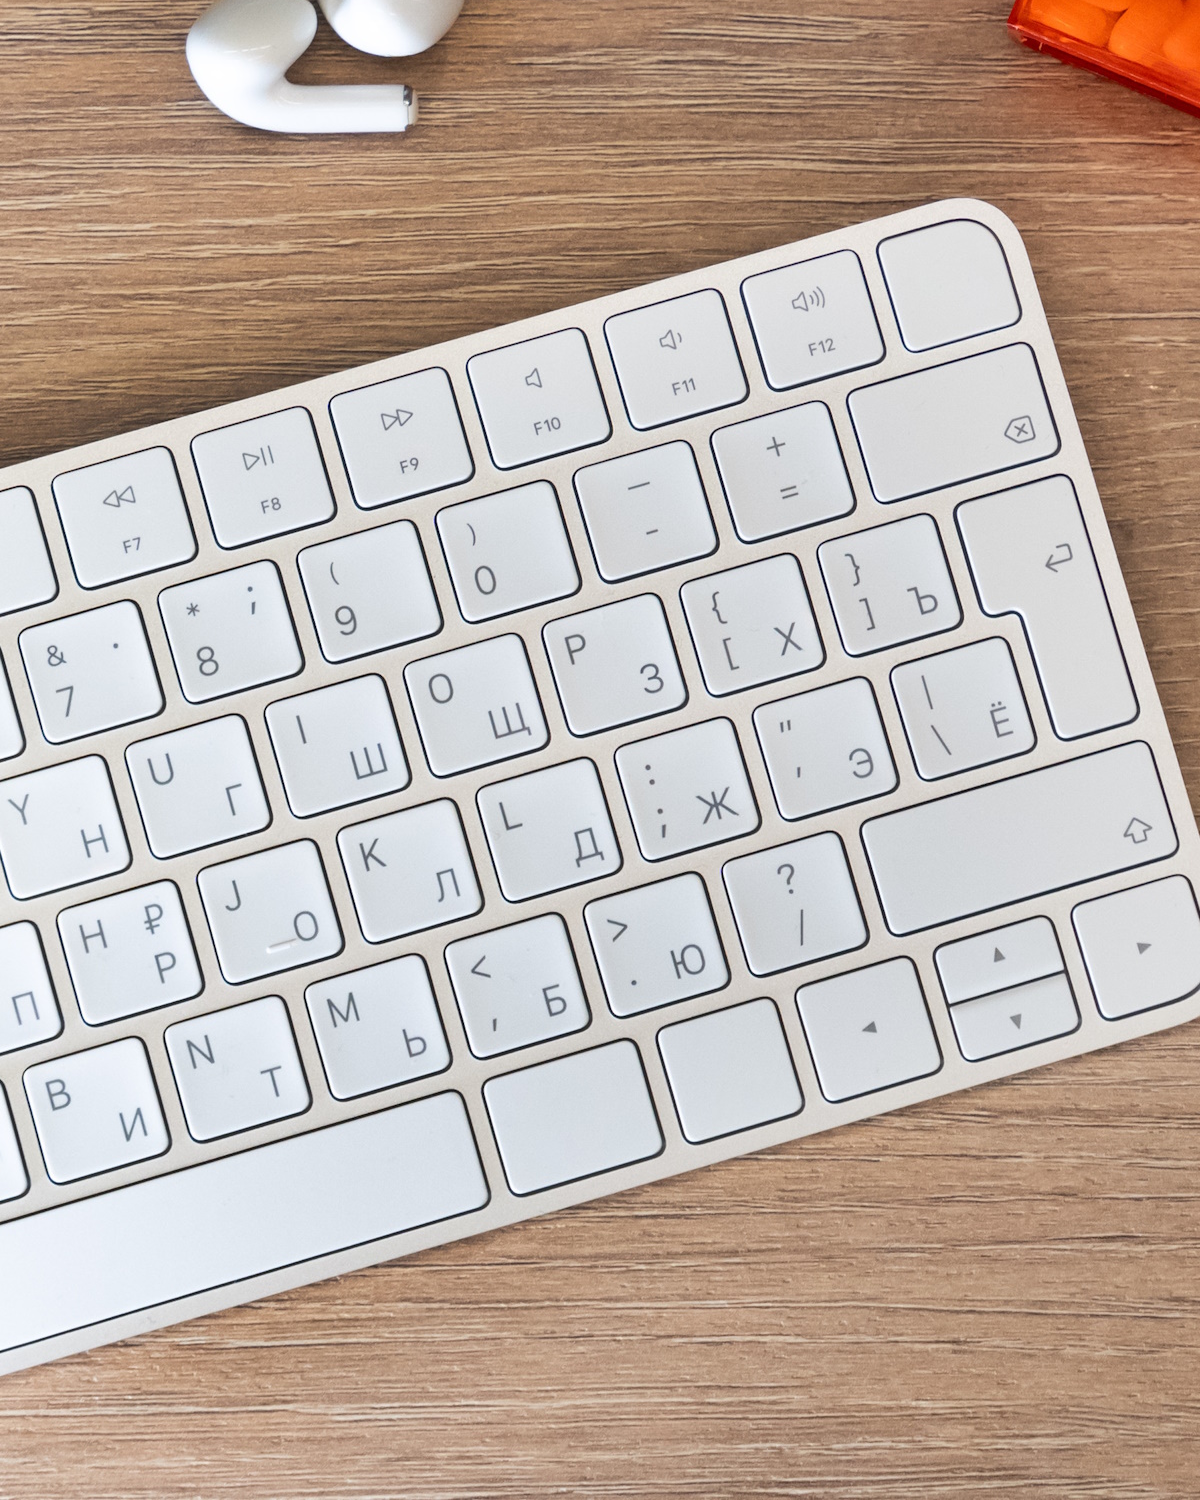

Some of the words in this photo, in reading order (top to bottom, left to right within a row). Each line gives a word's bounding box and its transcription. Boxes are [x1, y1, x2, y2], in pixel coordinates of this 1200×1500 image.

[808, 338, 836, 356] F12
[672, 378, 696, 396] F11
[533, 417, 561, 436] F10
[399, 457, 419, 474] F9
[260, 497, 281, 514] F8
[122, 537, 141, 554] F7
[907, 586, 939, 615] Ъ
[334, 605, 358, 636] 9
[47, 645, 68, 668] &
[196, 646, 219, 678] 8
[564, 634, 587, 665] P
[55, 685, 75, 718] 7
[488, 702, 532, 739] Щ
[989, 701, 1014, 738] Ё
[147, 753, 174, 786] U
[349, 743, 388, 780] Ш
[849, 748, 875, 779] Э
[8, 794, 30, 826] Y
[225, 783, 242, 816] Г
[696, 786, 739, 826] Ж
[498, 802, 523, 831] L
[80, 824, 110, 858] Н
[359, 838, 388, 872] K
[574, 827, 605, 868] Д
[436, 868, 461, 903] Л
[777, 863, 796, 895] ?
[225, 880, 242, 912] J
[79, 919, 108, 954] H
[670, 944, 706, 979] Ю
[11, 991, 40, 1025] П
[326, 992, 361, 1028] M
[542, 984, 568, 1017] Б
[186, 1034, 216, 1069] N
[402, 1028, 427, 1058] Ь
[45, 1079, 72, 1112] B
[119, 1107, 149, 1142] И
